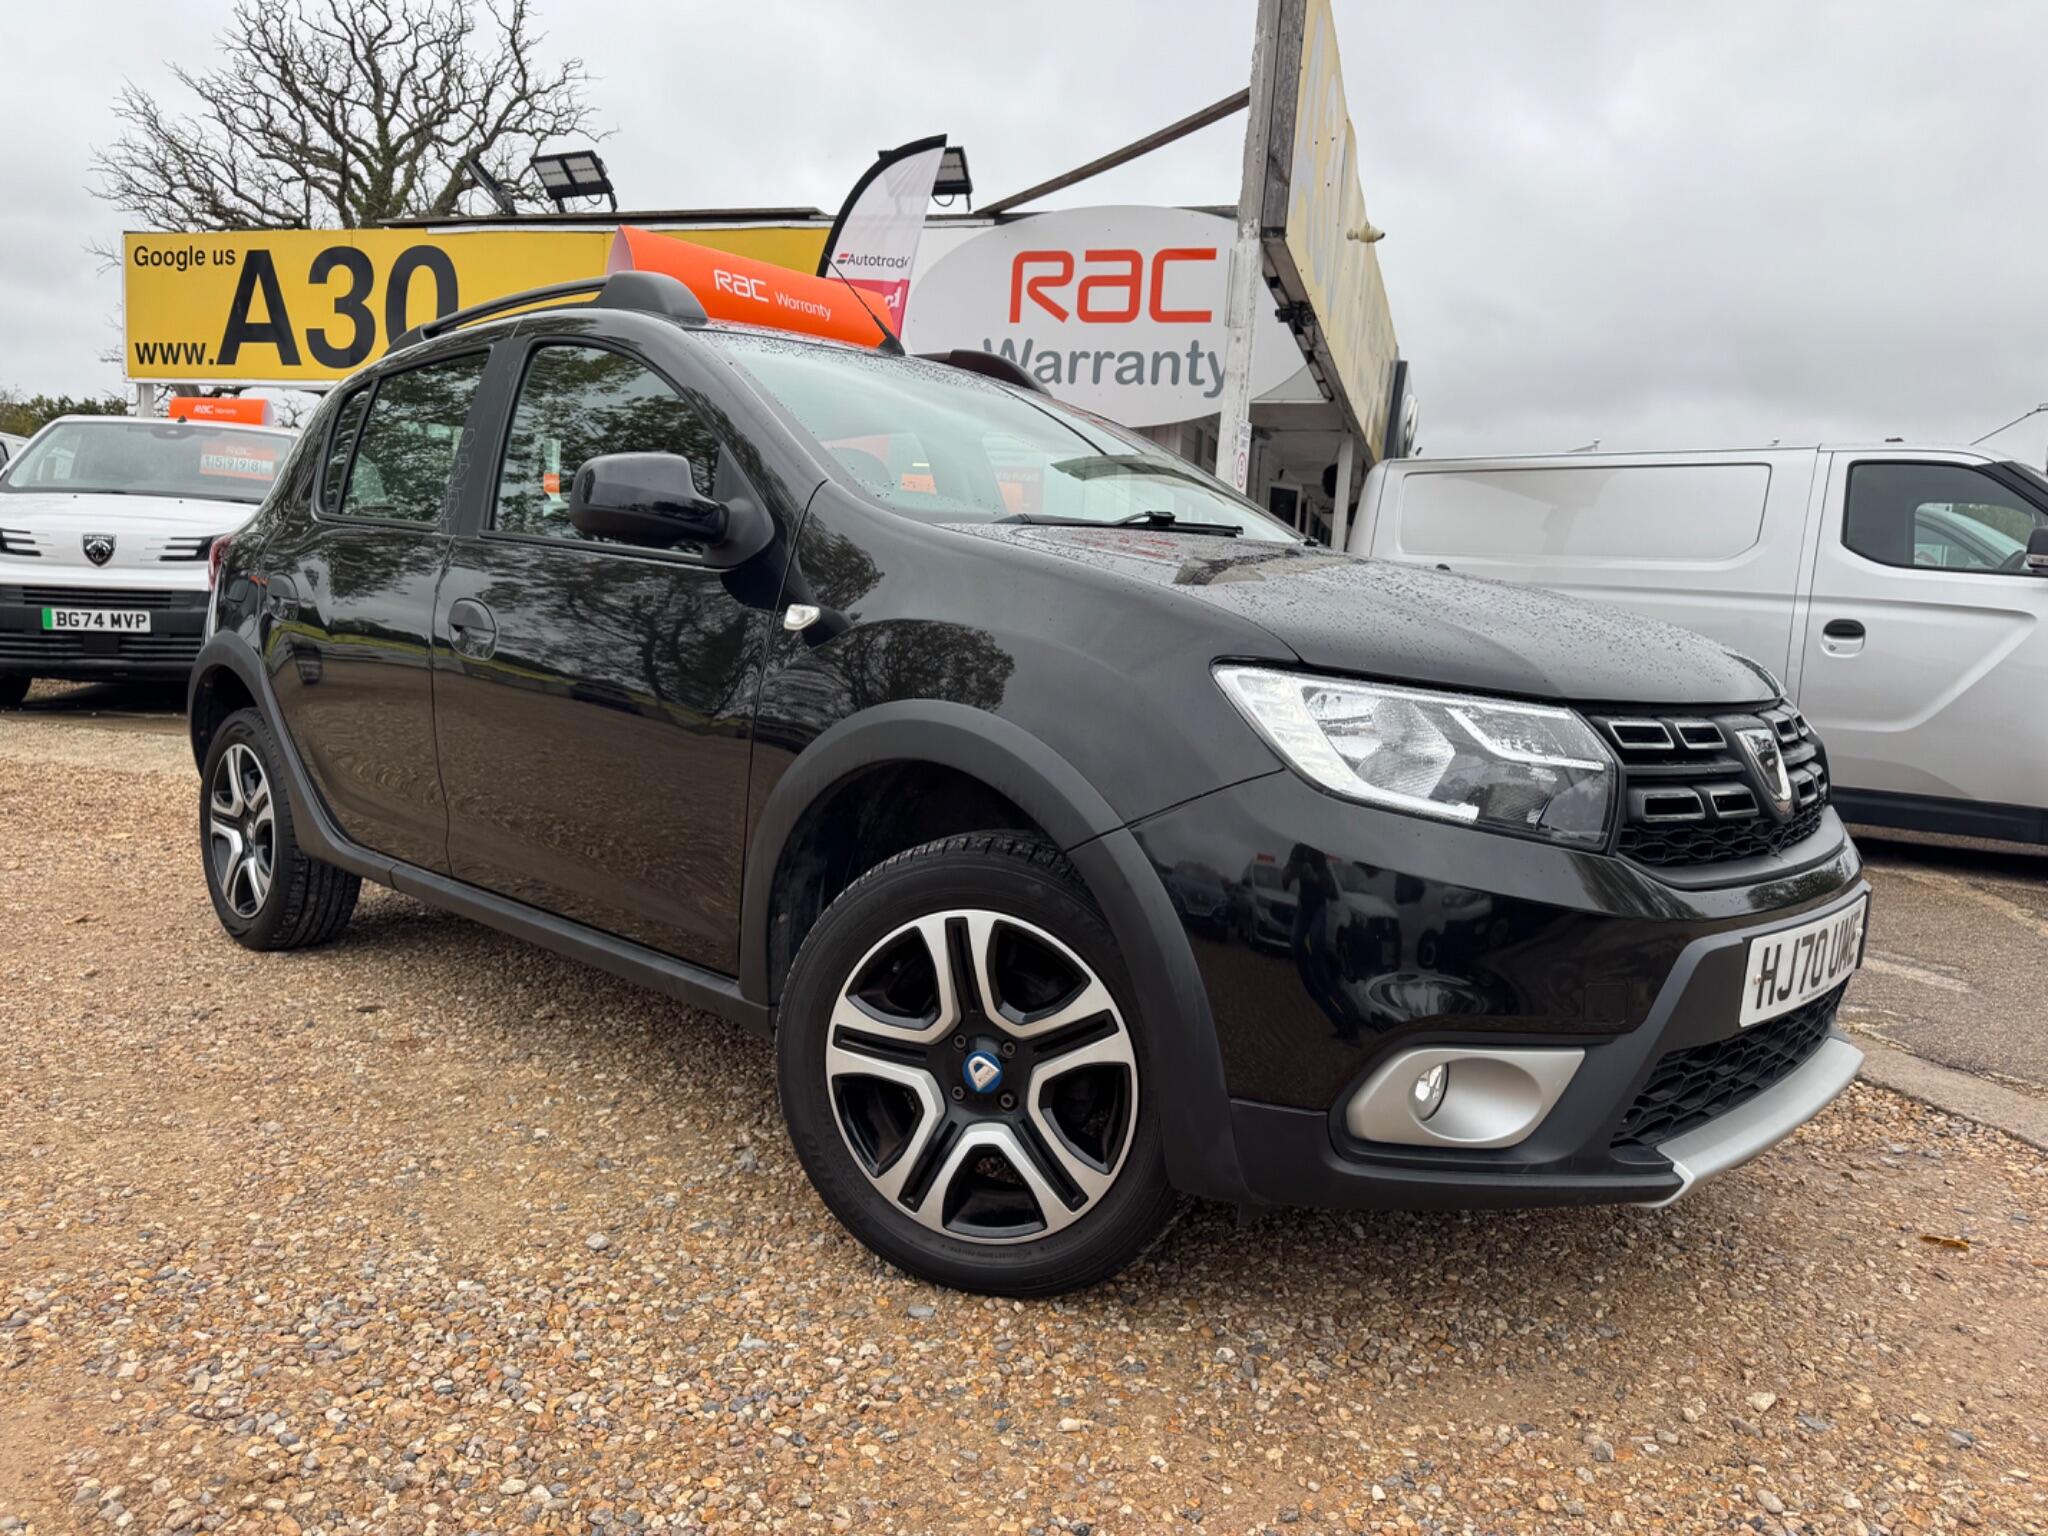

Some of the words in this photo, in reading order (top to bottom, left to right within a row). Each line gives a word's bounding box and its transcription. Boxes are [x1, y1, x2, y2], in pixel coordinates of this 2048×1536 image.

[134, 245, 206, 272] Google
[213, 249, 236, 266] us
[774, 291, 832, 322] Warranty
[56, 611, 105, 628] BG74
[110, 612, 147, 629] MVP
[1756, 928, 1829, 1010] HJ70
